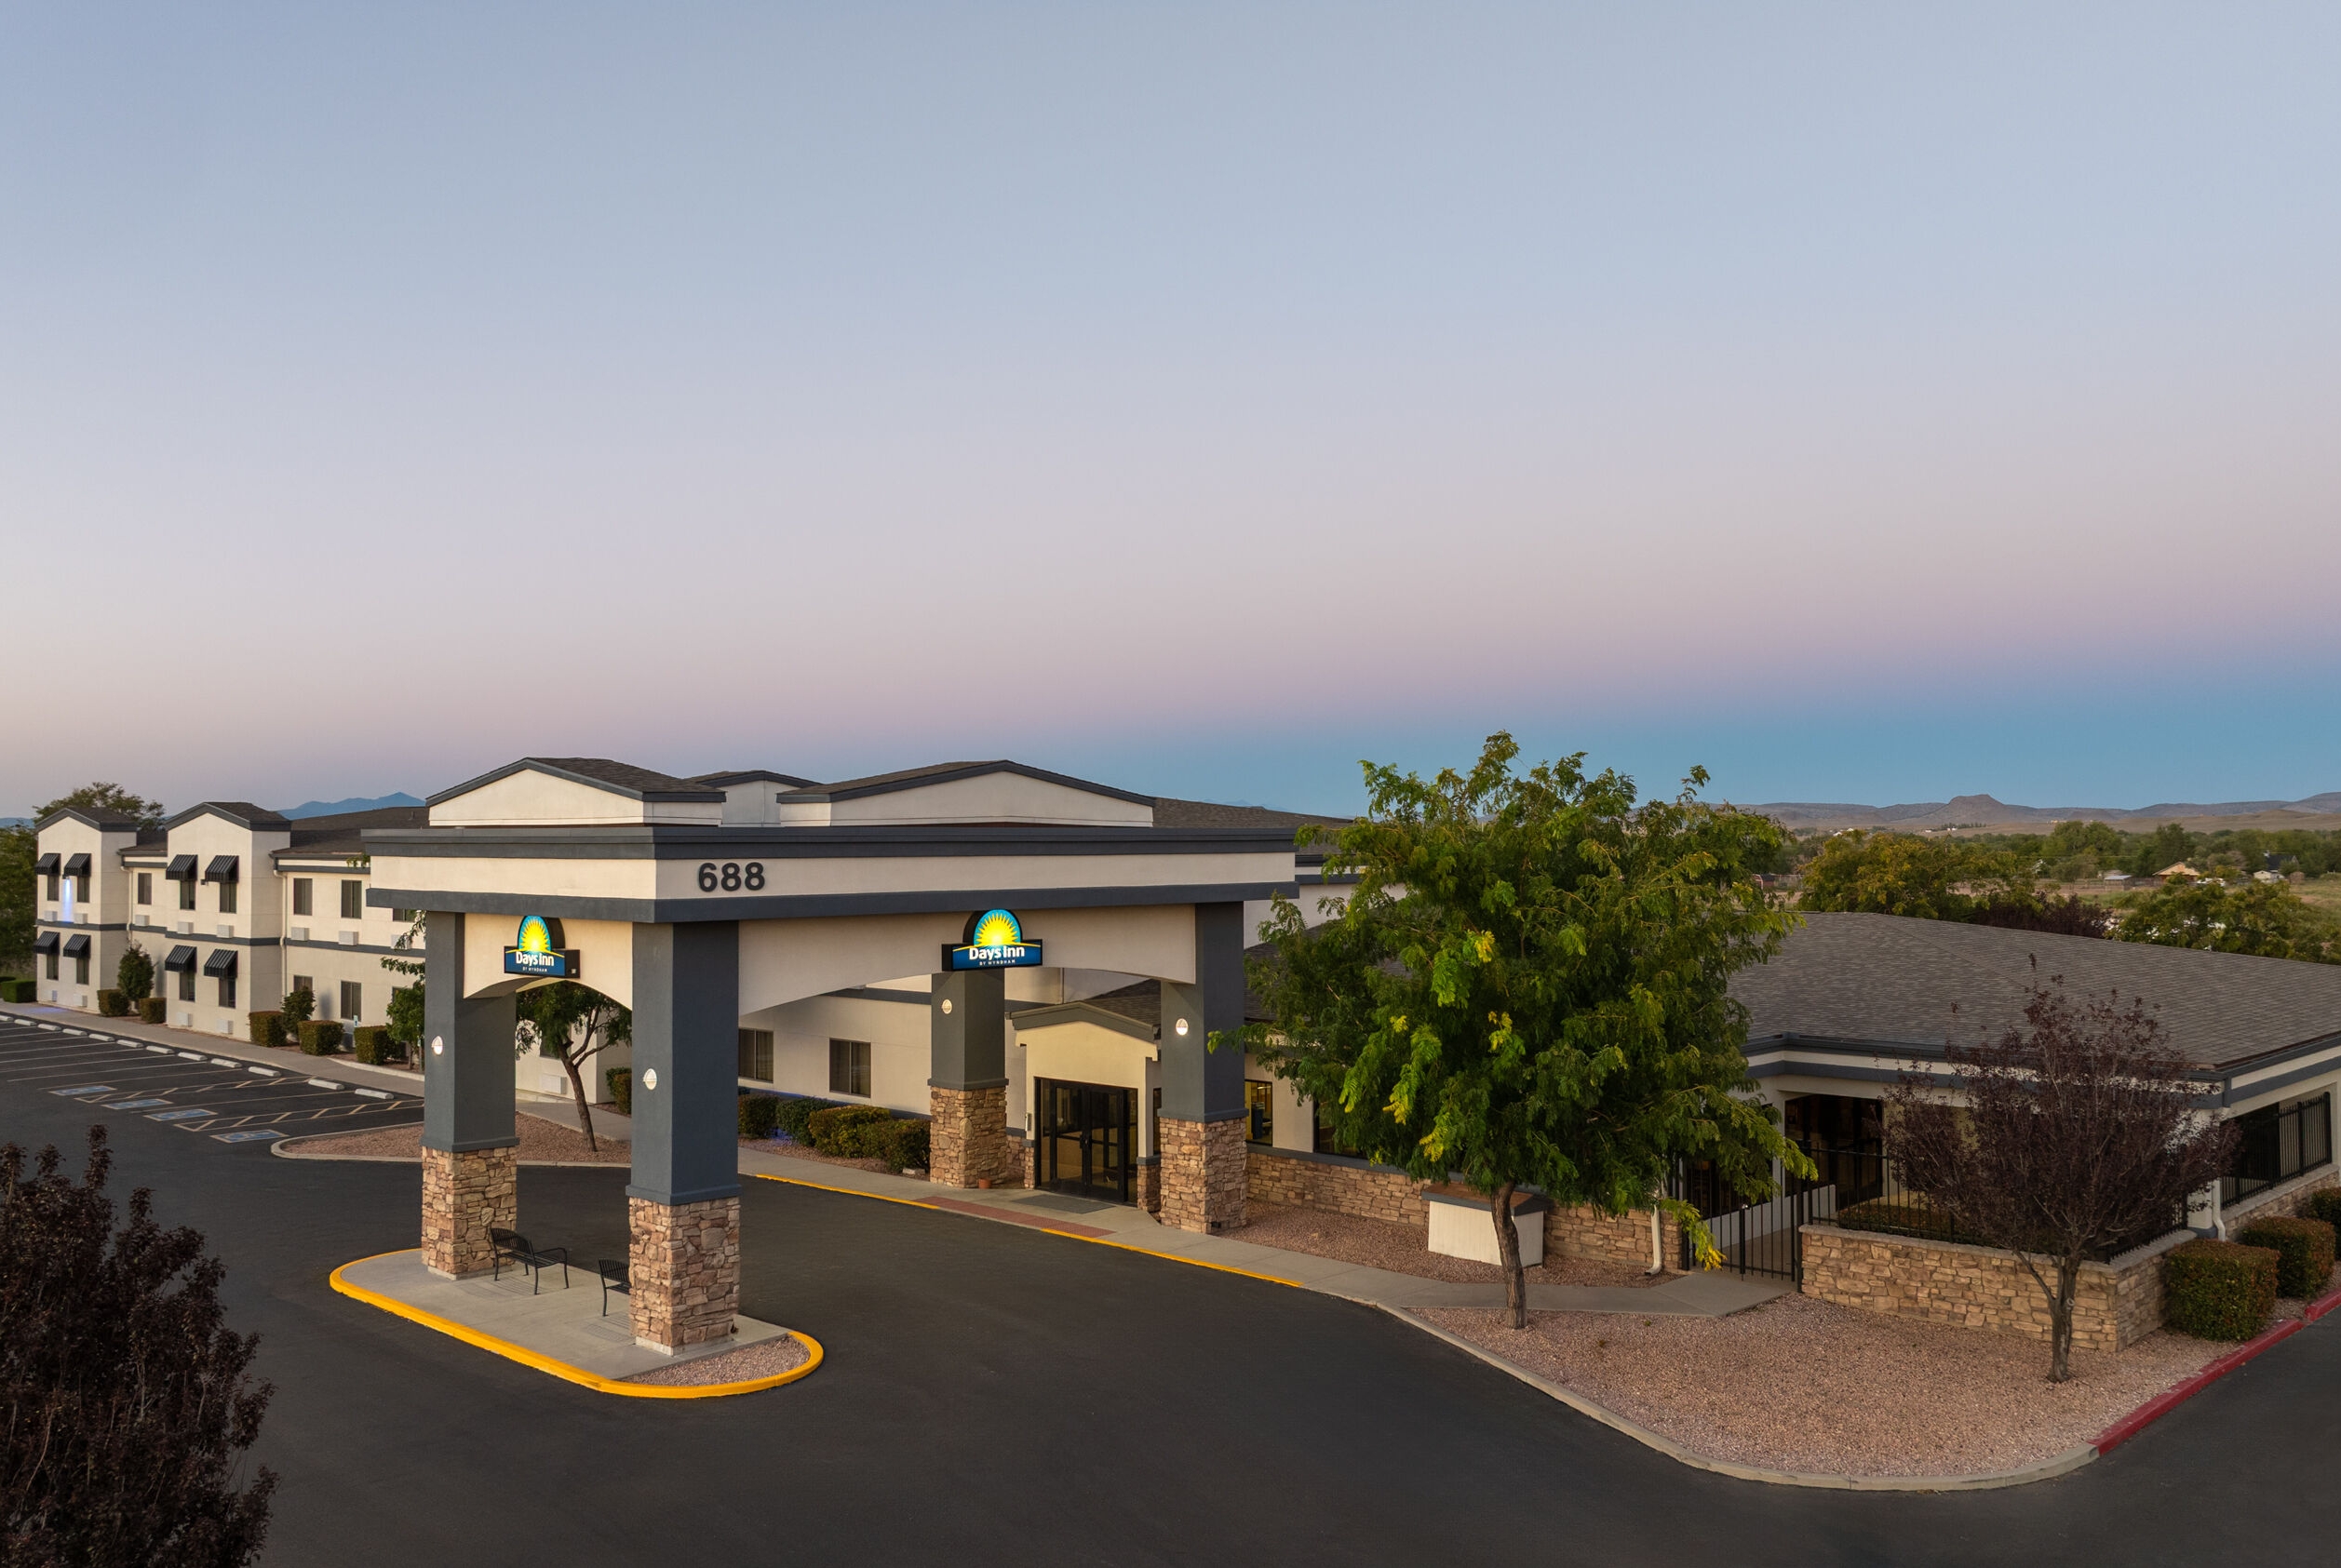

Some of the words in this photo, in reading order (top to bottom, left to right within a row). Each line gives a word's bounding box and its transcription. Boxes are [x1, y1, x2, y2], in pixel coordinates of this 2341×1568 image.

[698, 862, 765, 892] 688
[516, 951, 538, 966] Days
[539, 953, 555, 966] Inn
[969, 947, 1002, 960] Days
[1002, 946, 1025, 958] Inn
